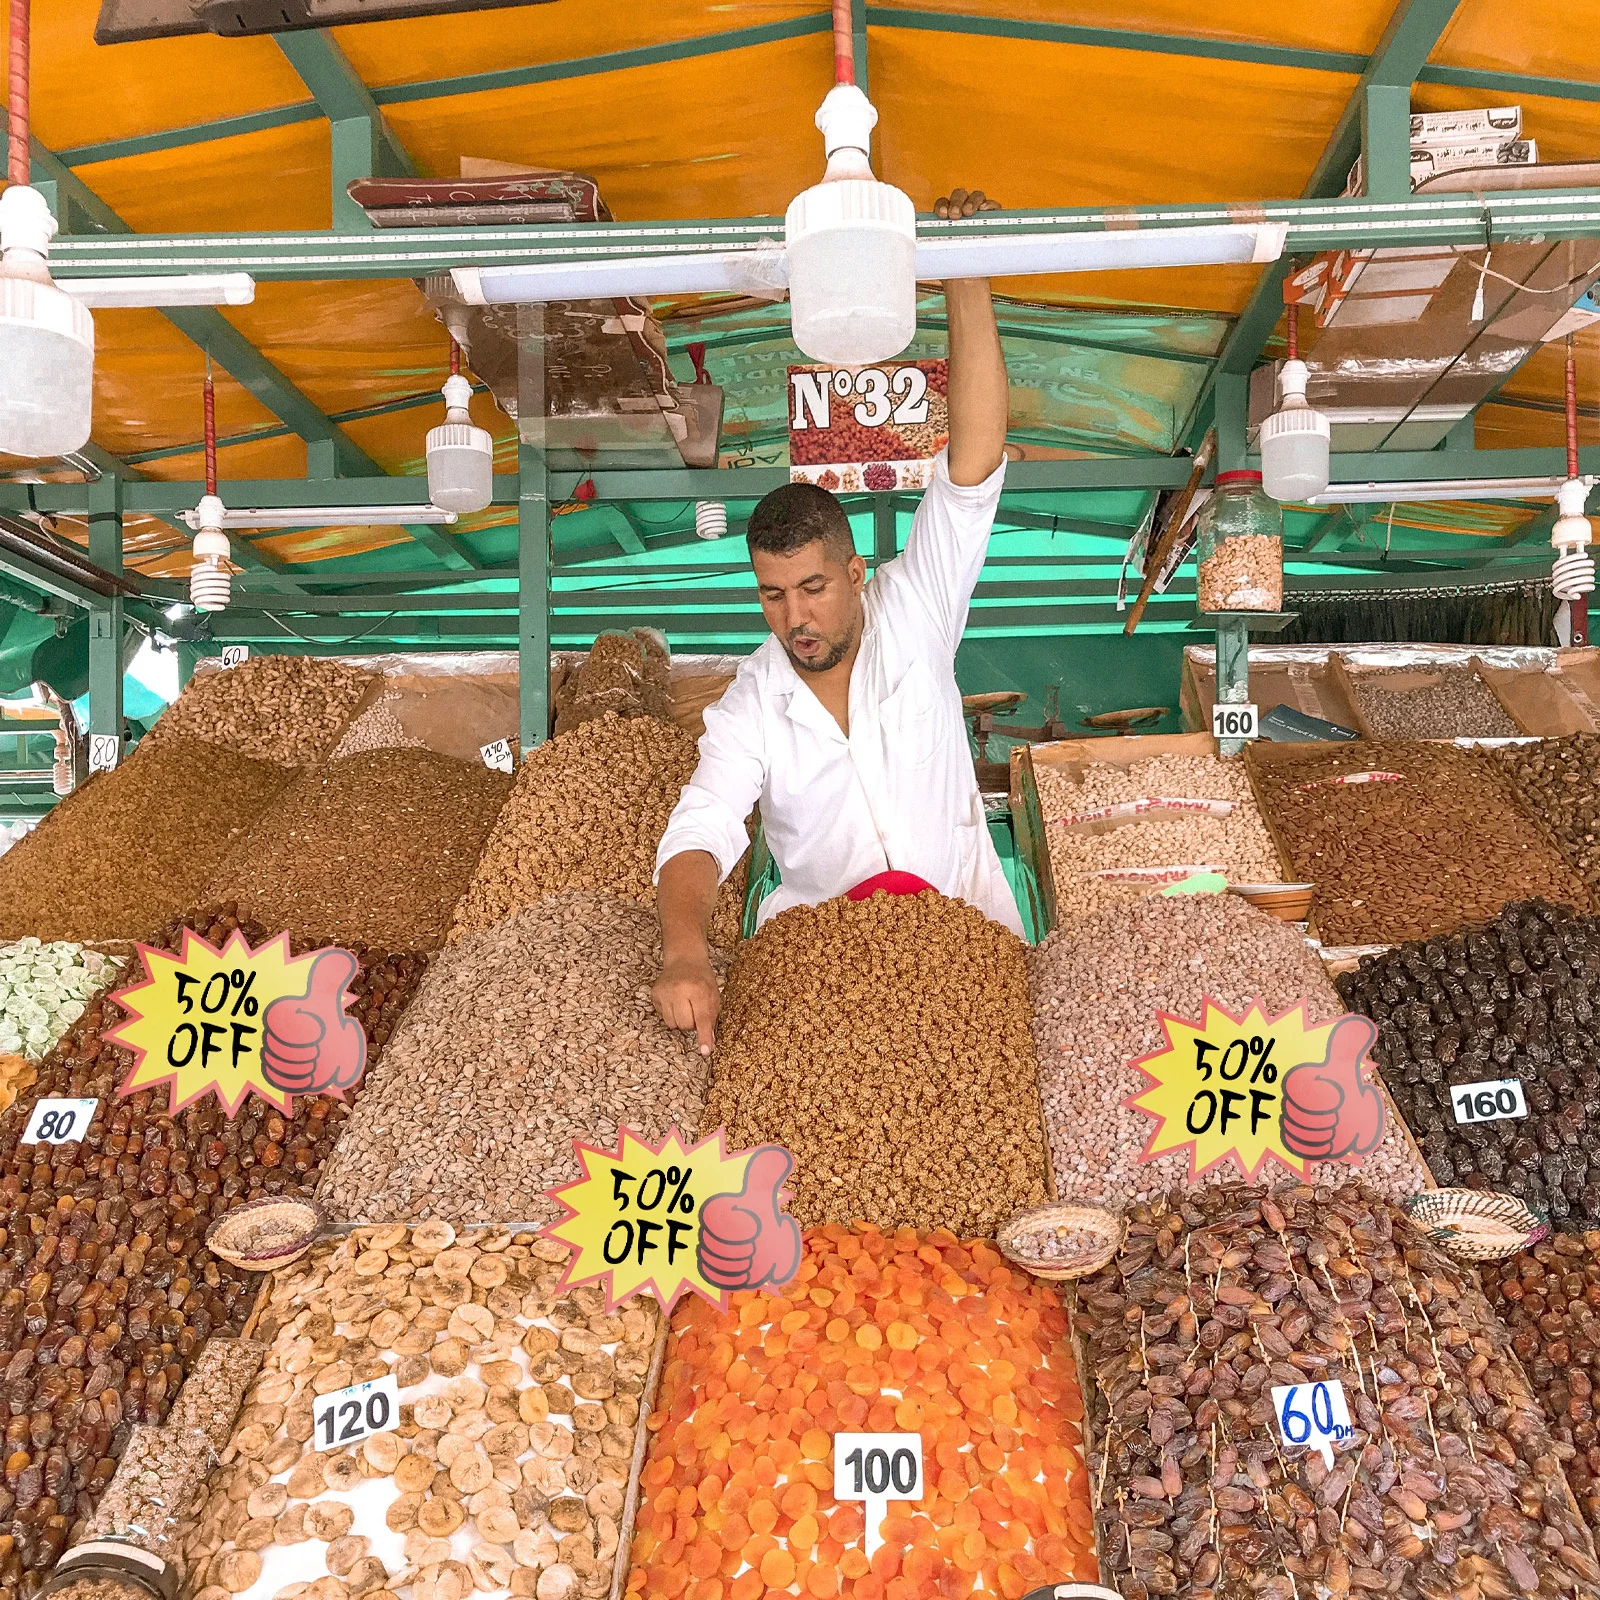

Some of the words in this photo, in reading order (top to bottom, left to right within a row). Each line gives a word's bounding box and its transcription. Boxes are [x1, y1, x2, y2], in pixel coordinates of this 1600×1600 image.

[223, 647, 241, 666] 60
[1214, 711, 1253, 735] 160
[93, 736, 116, 766] 80
[484, 741, 503, 758] 140
[1457, 1088, 1517, 1119] 160
[36, 1110, 77, 1140] 80
[317, 1391, 390, 1445] 120
[1281, 1382, 1334, 1443] 60
[844, 1447, 917, 1494] 100
